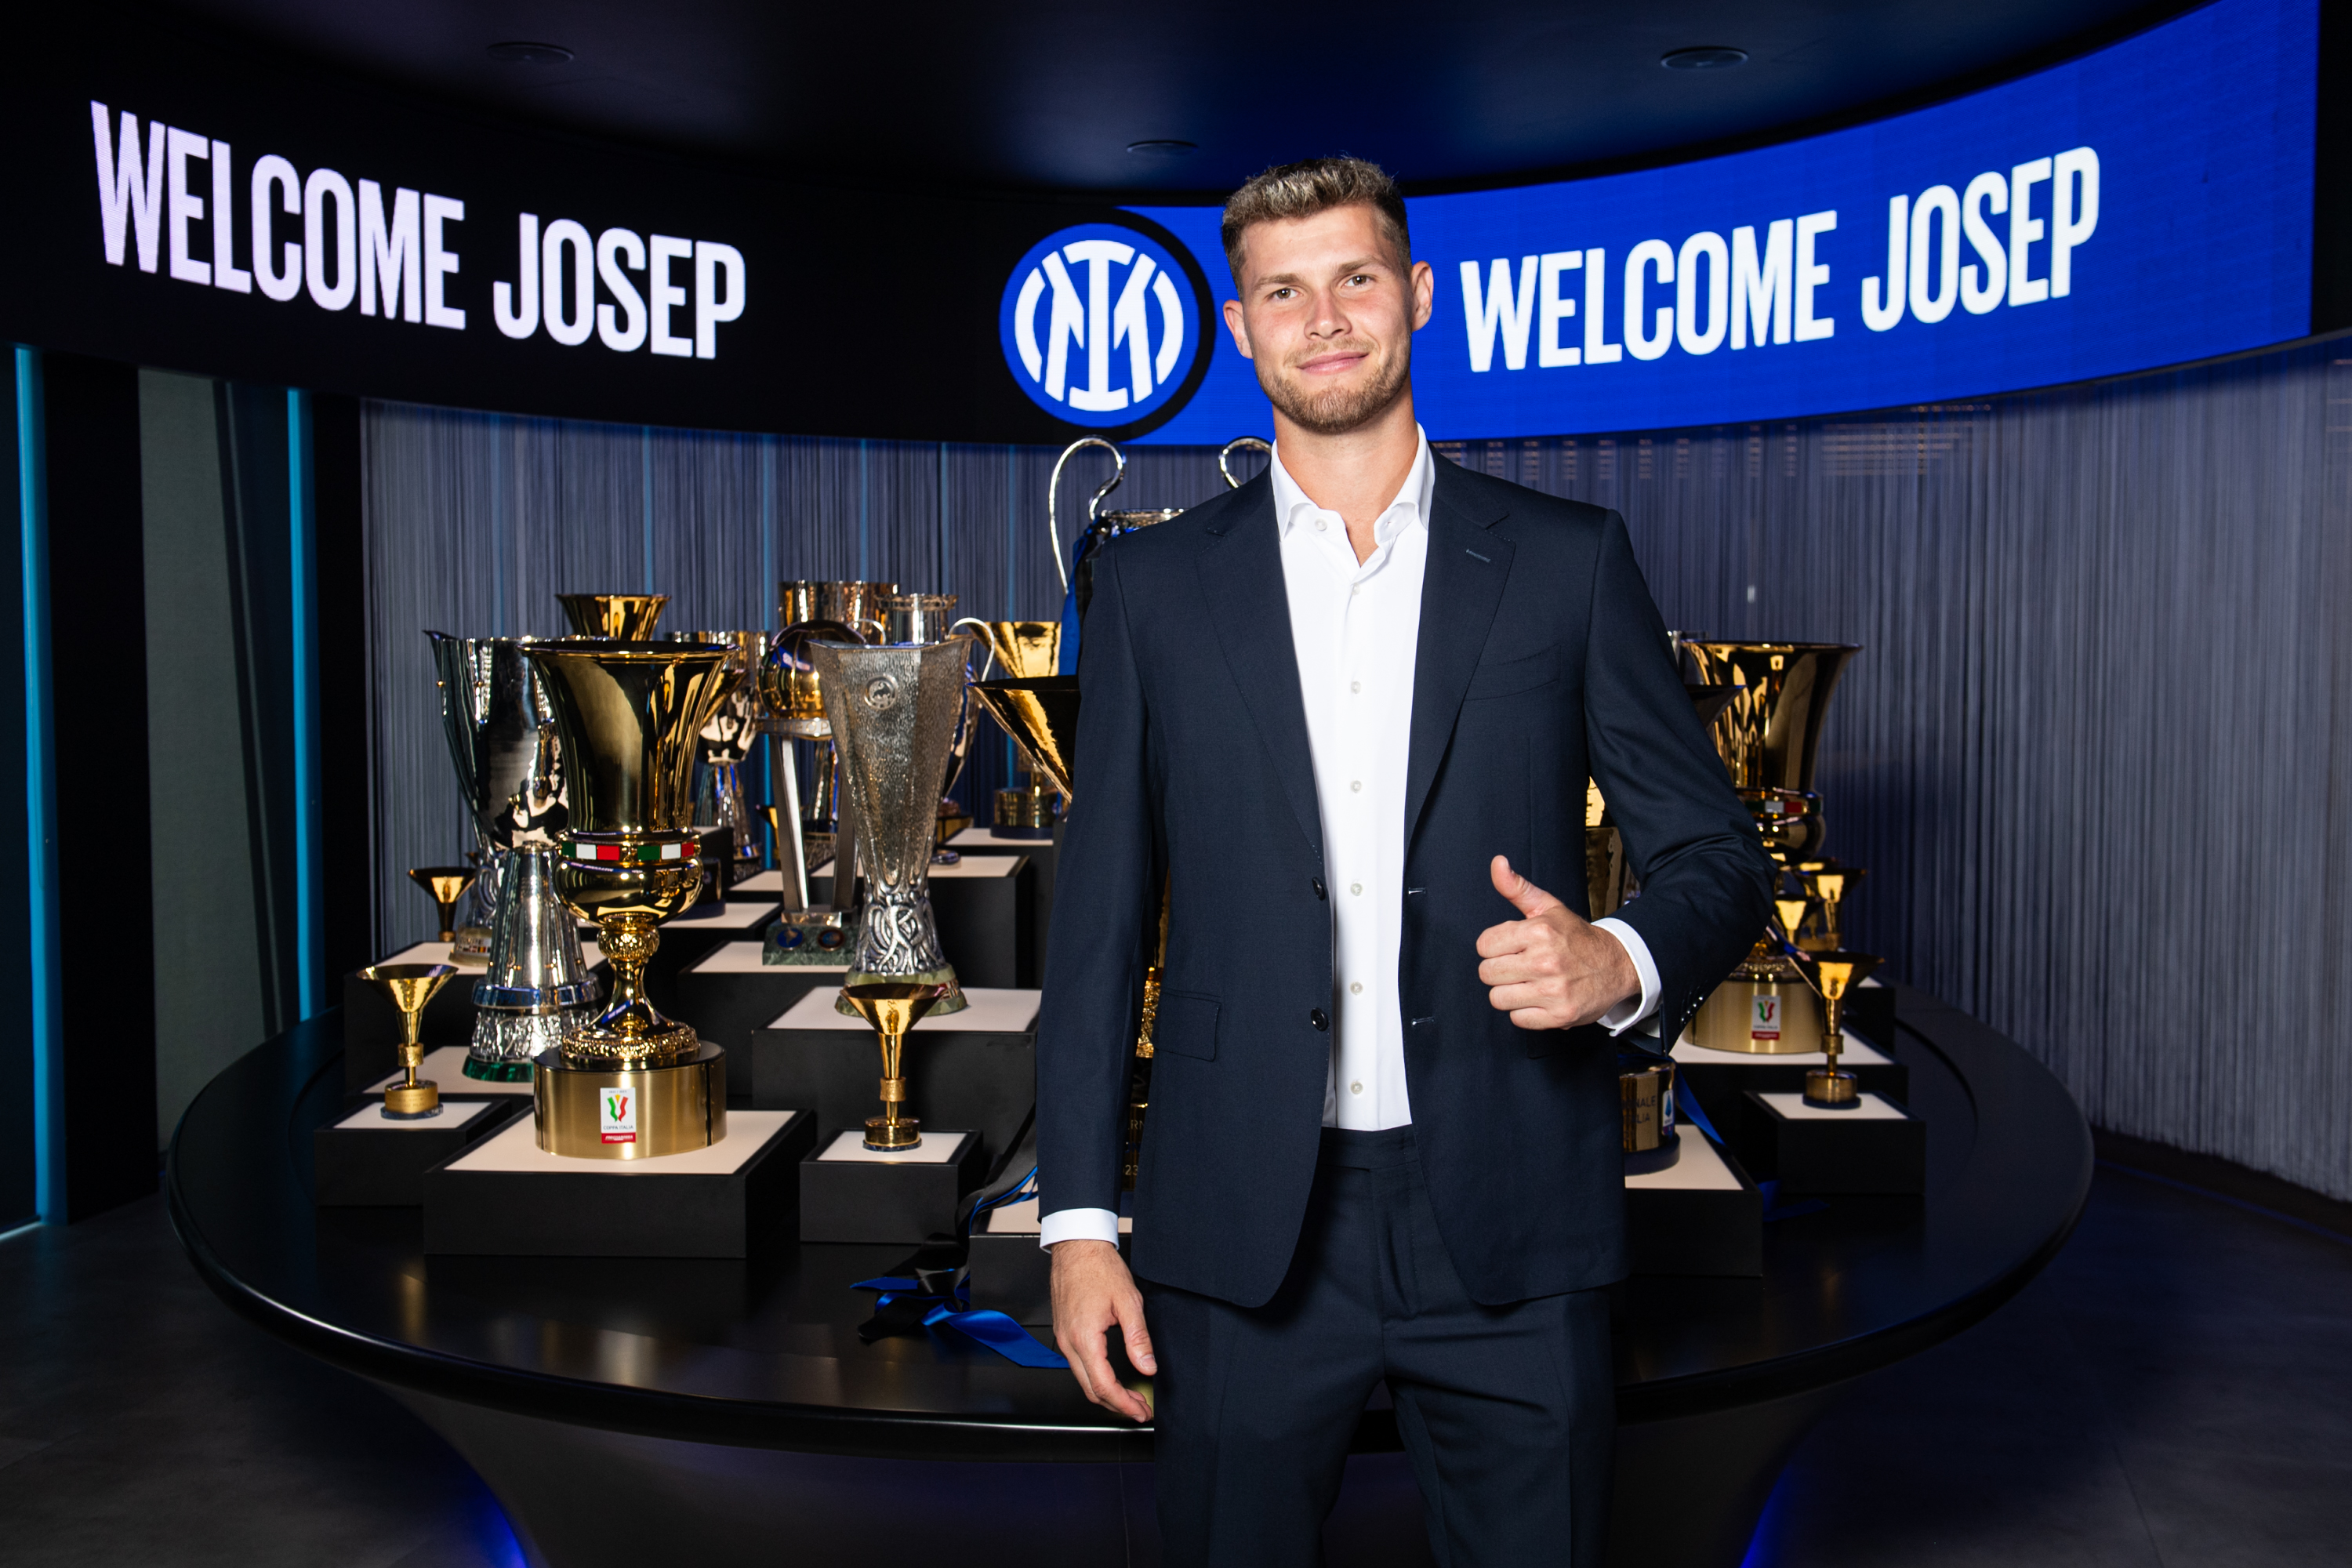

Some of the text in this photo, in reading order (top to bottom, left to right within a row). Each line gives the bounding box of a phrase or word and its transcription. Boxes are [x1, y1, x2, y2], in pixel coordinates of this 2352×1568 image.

[91, 101, 745, 359] WELCOME JOSEP
[1460, 147, 2100, 372] WELCOME JOSEP
[773, 720, 829, 733] EUROP
